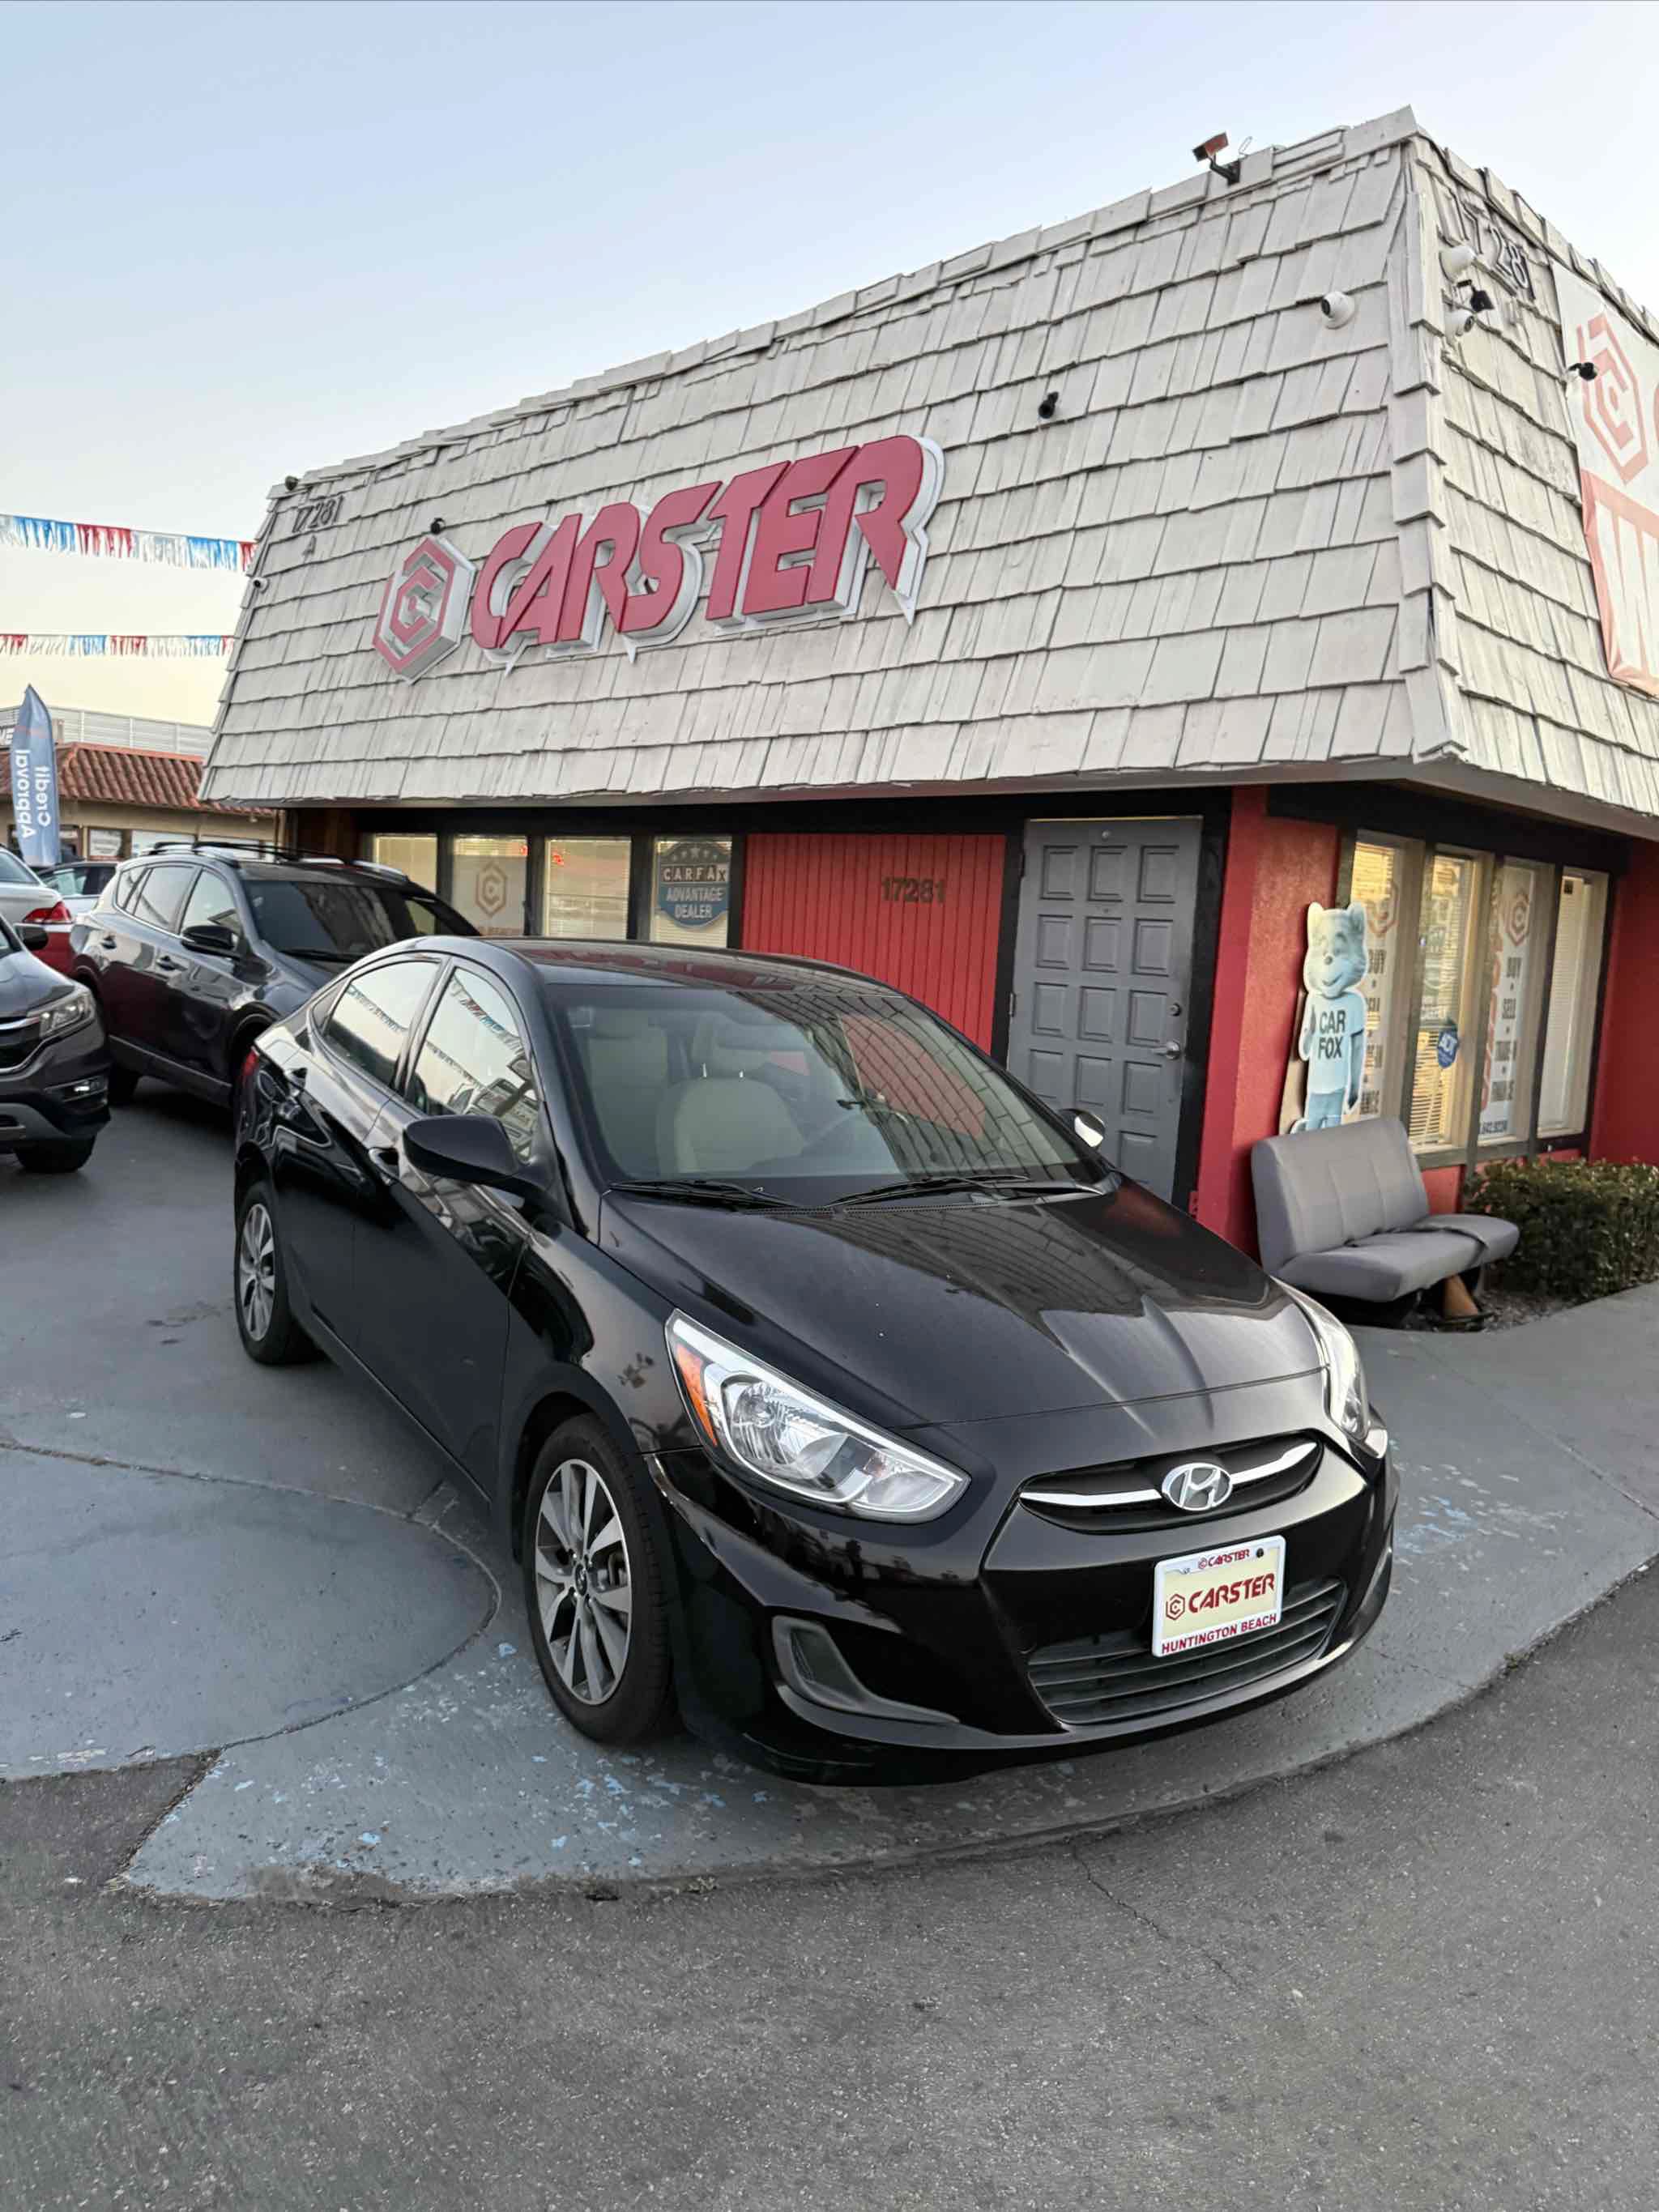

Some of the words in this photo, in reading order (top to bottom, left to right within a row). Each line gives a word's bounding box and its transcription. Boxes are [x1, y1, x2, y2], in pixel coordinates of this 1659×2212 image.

[292, 495, 343, 533] 17281
[469, 434, 928, 650] CARSTER
[663, 865, 727, 881] CARFAX
[666, 888, 723, 901] ADVANTAGE
[883, 877, 946, 902] 17281
[674, 904, 713, 918] DEALER
[1319, 1009, 1346, 1034] CAR
[1318, 1036, 1344, 1059] FOX
[1208, 1549, 1250, 1567] CARSTER
[1188, 1572, 1276, 1613] CARSTER
[1161, 1623, 1238, 1654] HUNTINGTON
[1241, 1613, 1277, 1638] BEACH
